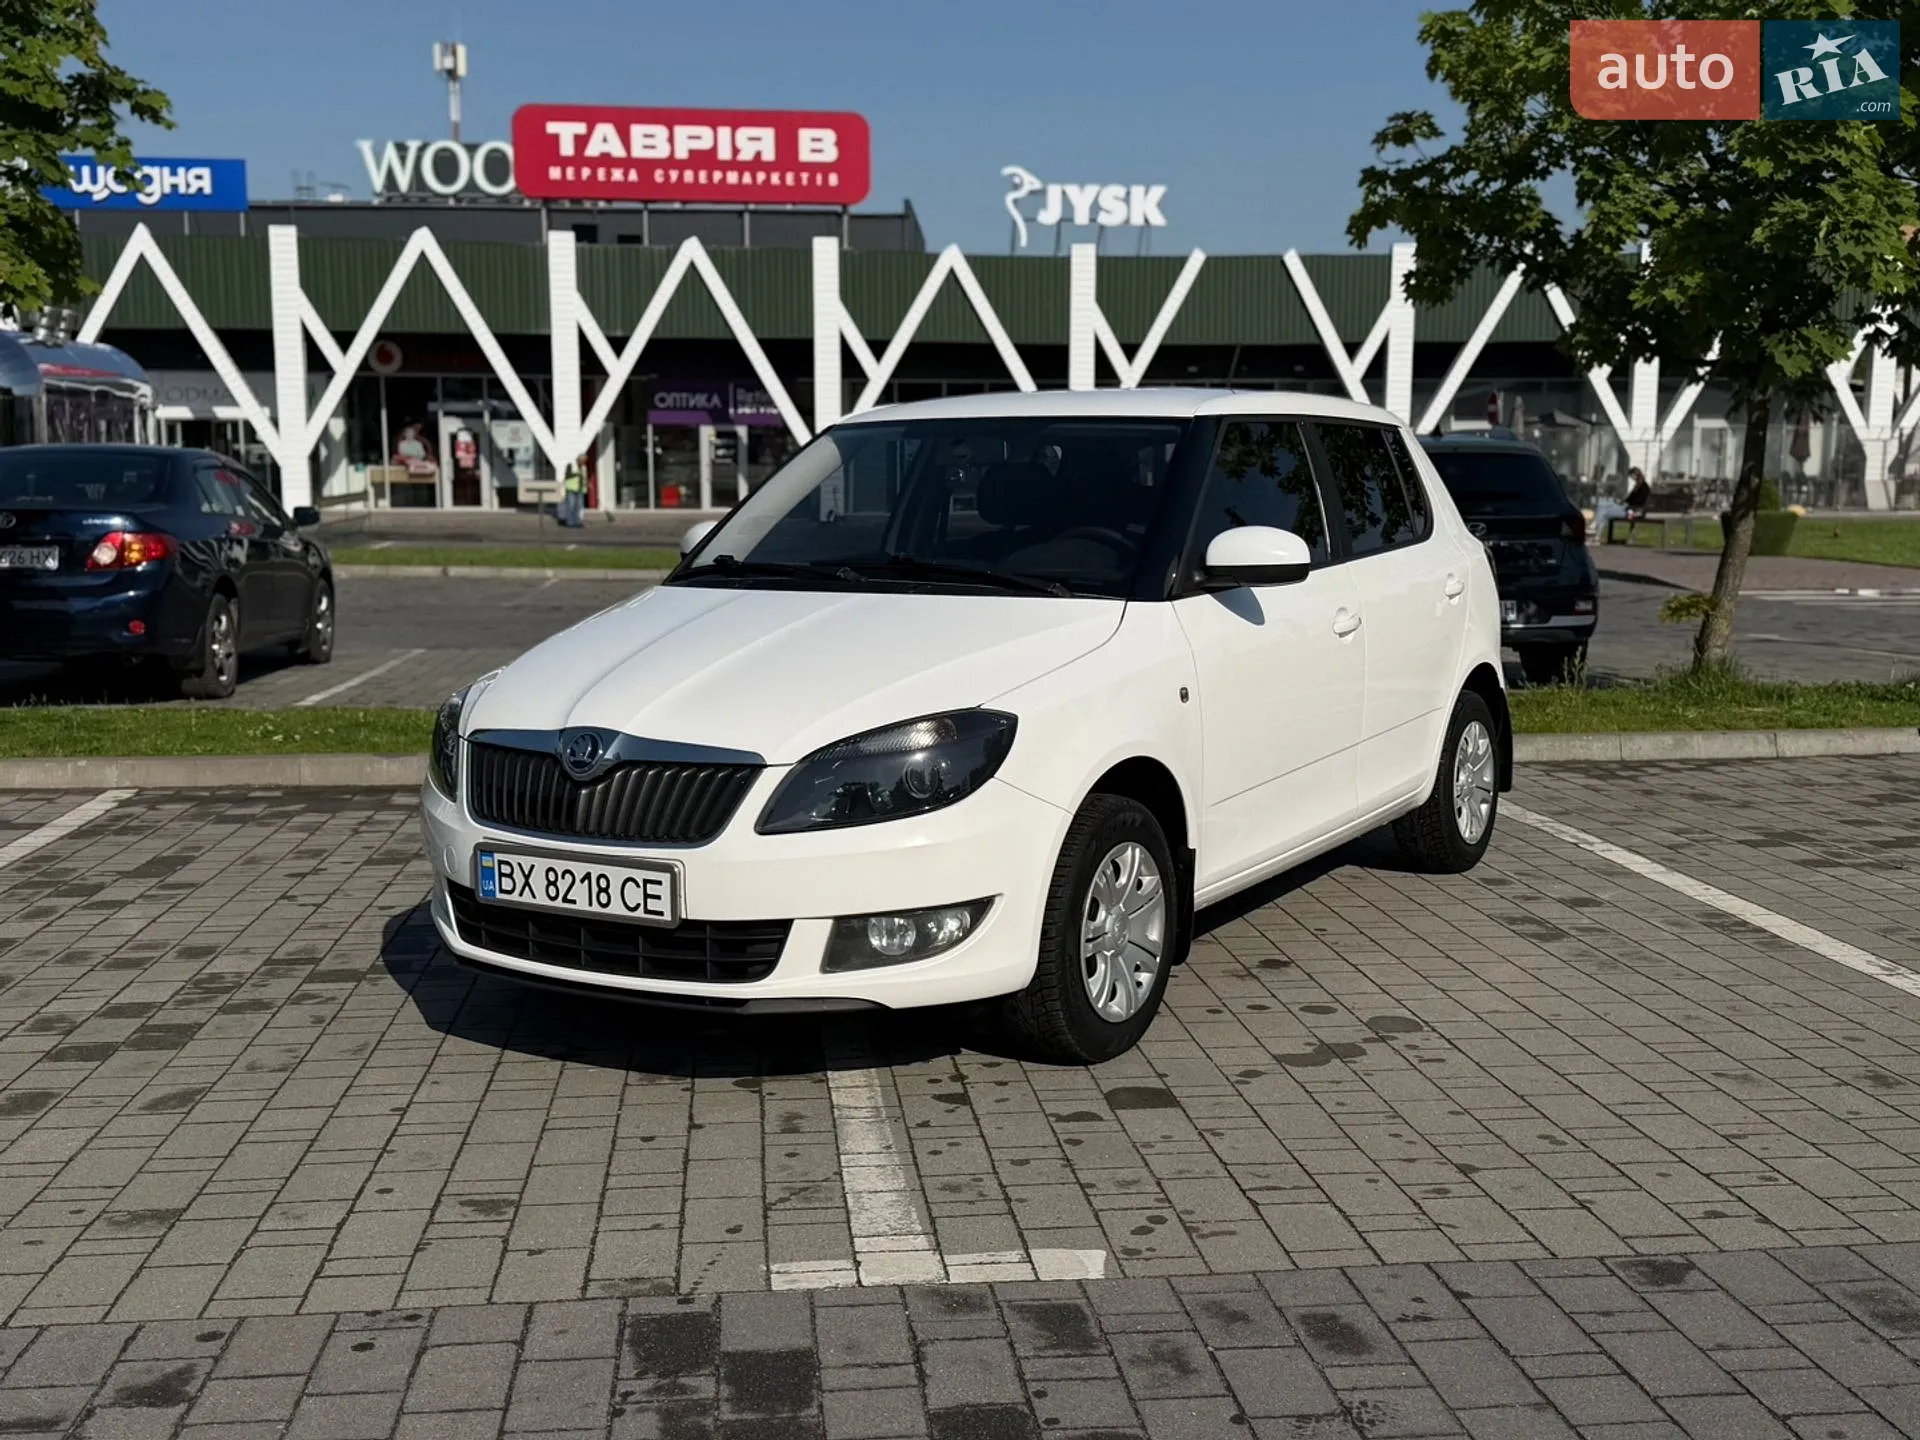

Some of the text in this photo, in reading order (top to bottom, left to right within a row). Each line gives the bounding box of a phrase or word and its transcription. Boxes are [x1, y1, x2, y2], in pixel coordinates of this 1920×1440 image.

[545, 121, 839, 163] ТАВРІЯ В
[548, 165, 839, 187] МЕРЕЖА СУПЕРМАРКЕТІВ
[1036, 183, 1167, 226] JYSK
[653, 391, 722, 409] ОПТИКА
[482, 880, 495, 892] UA
[497, 859, 665, 917] BX 8218 CE
